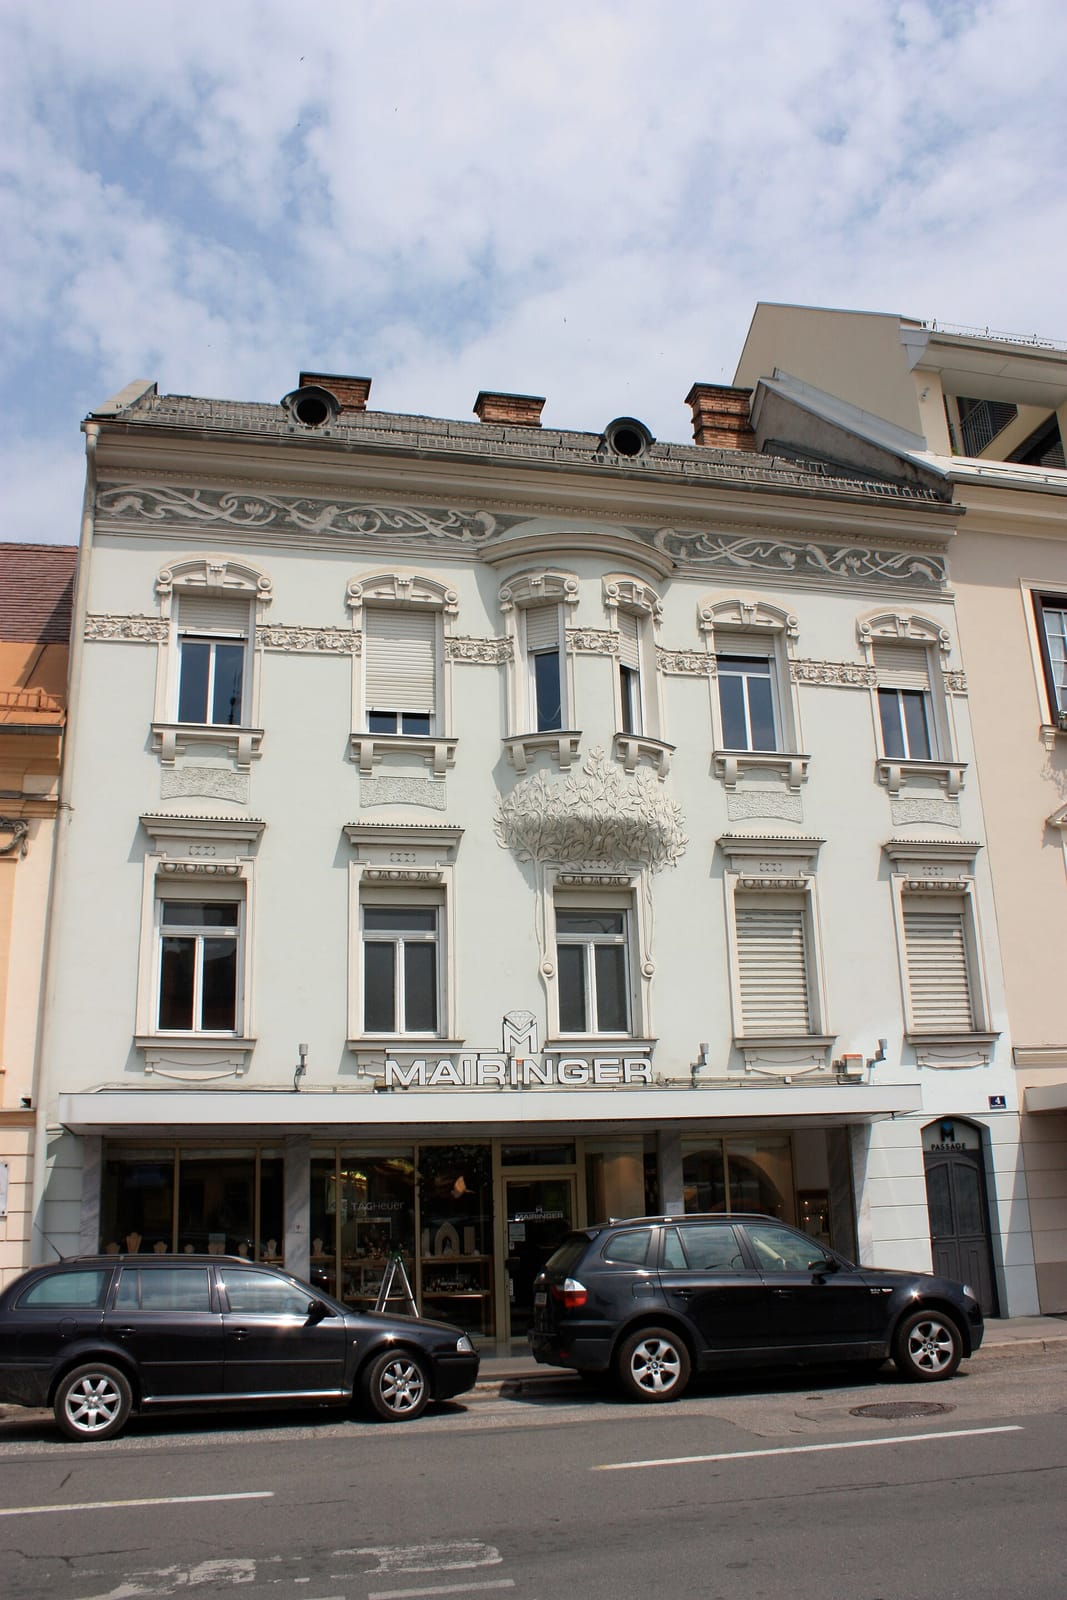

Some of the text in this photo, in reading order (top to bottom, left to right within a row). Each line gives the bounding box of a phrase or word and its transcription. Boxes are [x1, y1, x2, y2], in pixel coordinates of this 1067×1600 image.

[385, 1058, 652, 1086] MAIRINGER
[994, 1096, 1001, 1105] 4
[931, 1142, 967, 1151] PASSAGE
